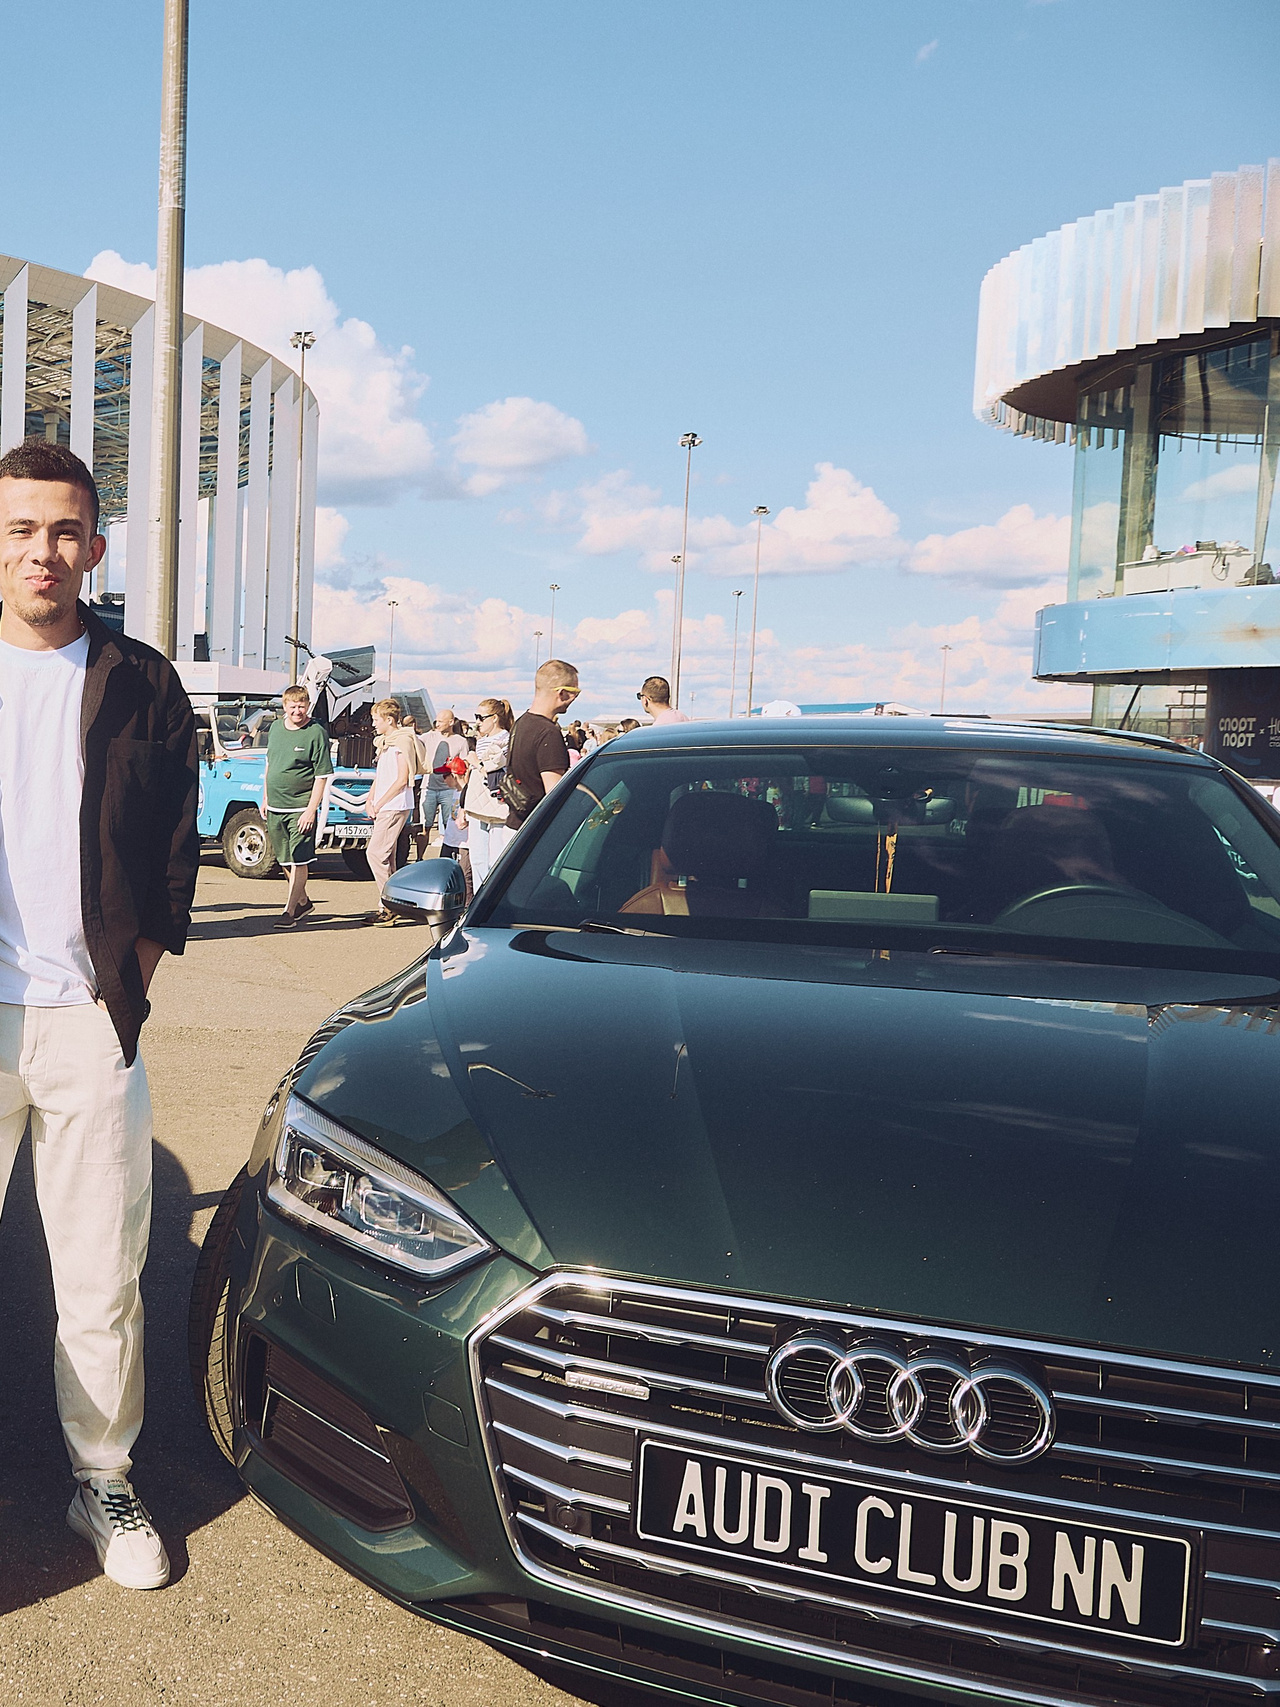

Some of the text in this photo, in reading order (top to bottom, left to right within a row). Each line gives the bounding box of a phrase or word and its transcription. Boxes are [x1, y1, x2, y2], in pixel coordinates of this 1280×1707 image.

[673, 1459, 1145, 1626] AUDI CLUB NN
